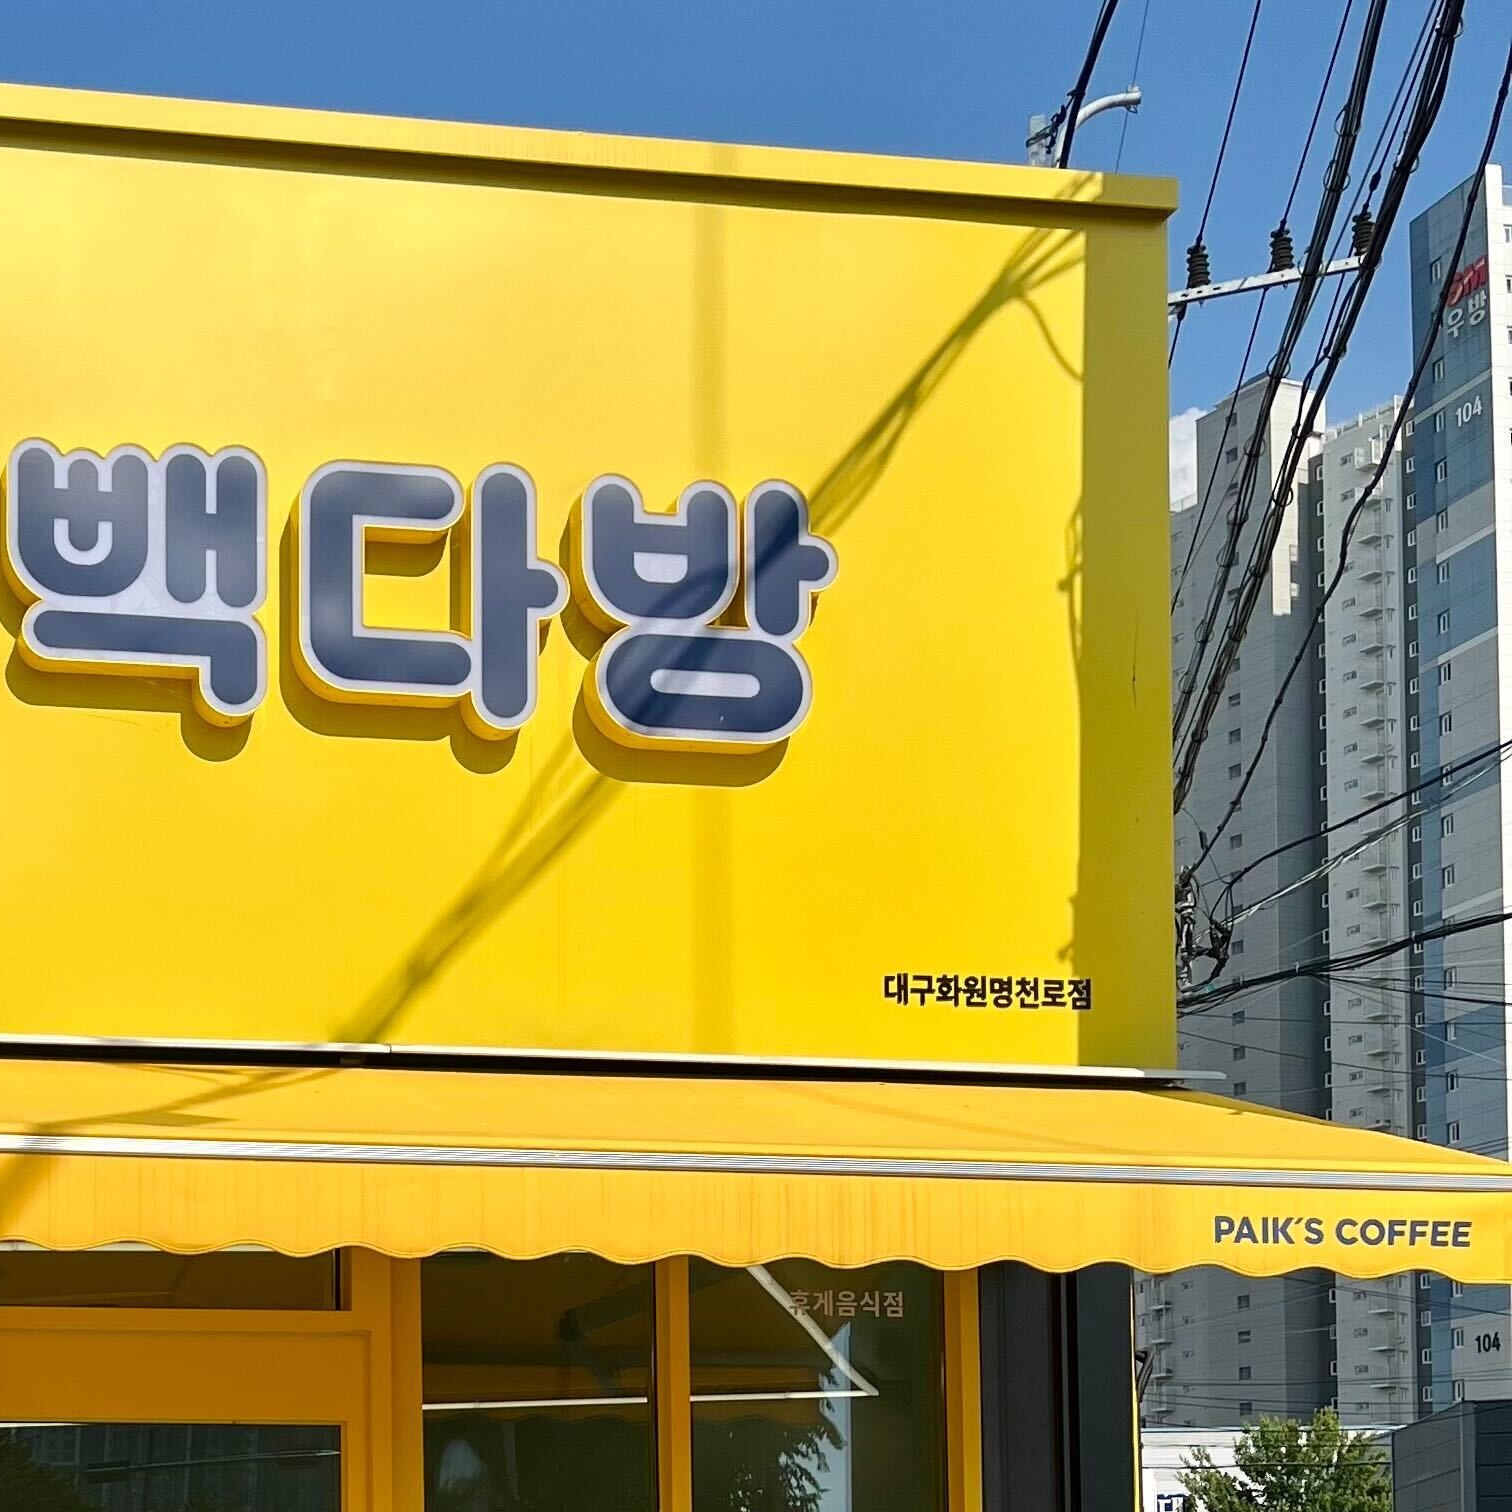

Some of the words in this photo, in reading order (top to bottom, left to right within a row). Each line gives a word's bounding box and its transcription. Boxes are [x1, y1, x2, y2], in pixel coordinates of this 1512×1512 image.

[1447, 289, 1487, 338] 우방
[1455, 395, 1484, 428] 104
[6, 436, 839, 750] 빽다방
[883, 973, 1092, 1010] 대구화원명천로점
[1214, 1215, 1325, 1245] PAIK'S
[1335, 1218, 1473, 1248] COFFEE
[789, 1289, 905, 1318] 휴게음식점
[1474, 1331, 1501, 1354] 104
